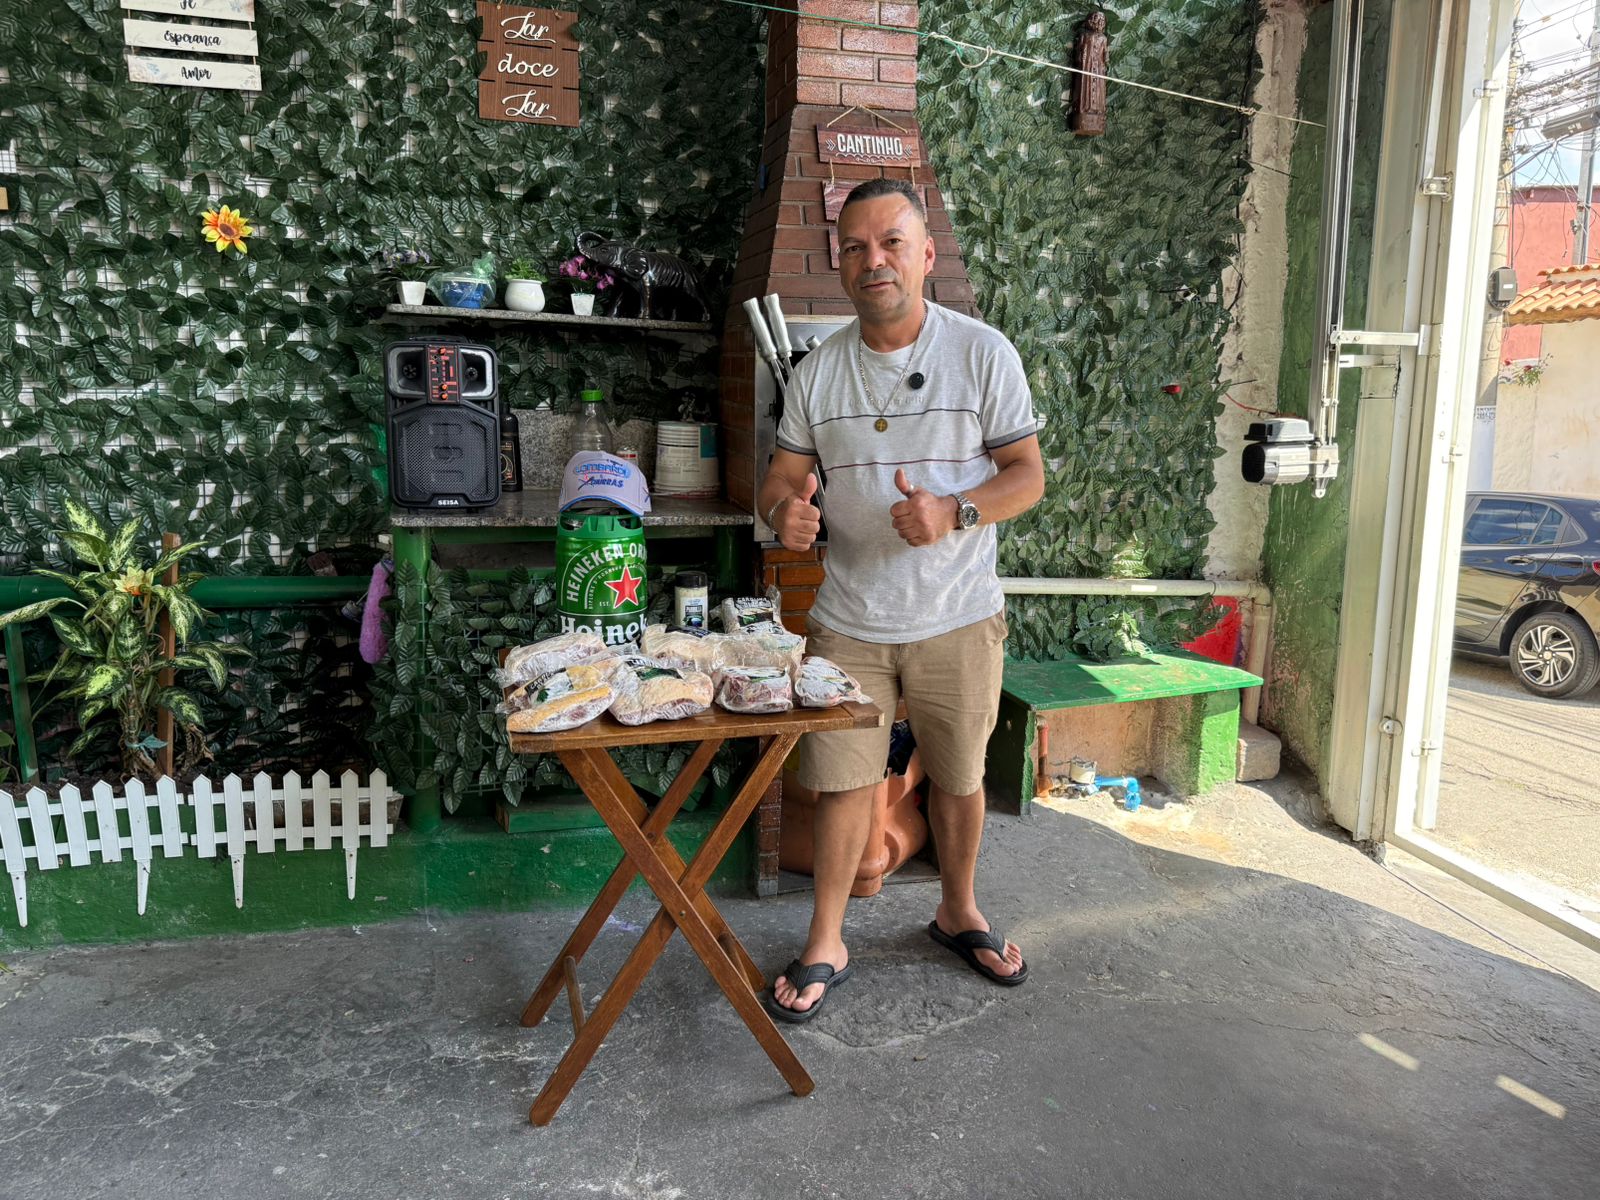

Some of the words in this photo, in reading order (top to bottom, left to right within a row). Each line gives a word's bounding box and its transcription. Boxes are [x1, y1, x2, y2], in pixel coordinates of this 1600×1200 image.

[164, 30, 221, 46] Esperança
[500, 11, 557, 43] Lar
[181, 66, 212, 81] Amor
[497, 53, 559, 77] doce
[502, 89, 557, 121] Lar
[836, 133, 903, 156] CANTINHO
[566, 543, 624, 602] HEINEKEN
